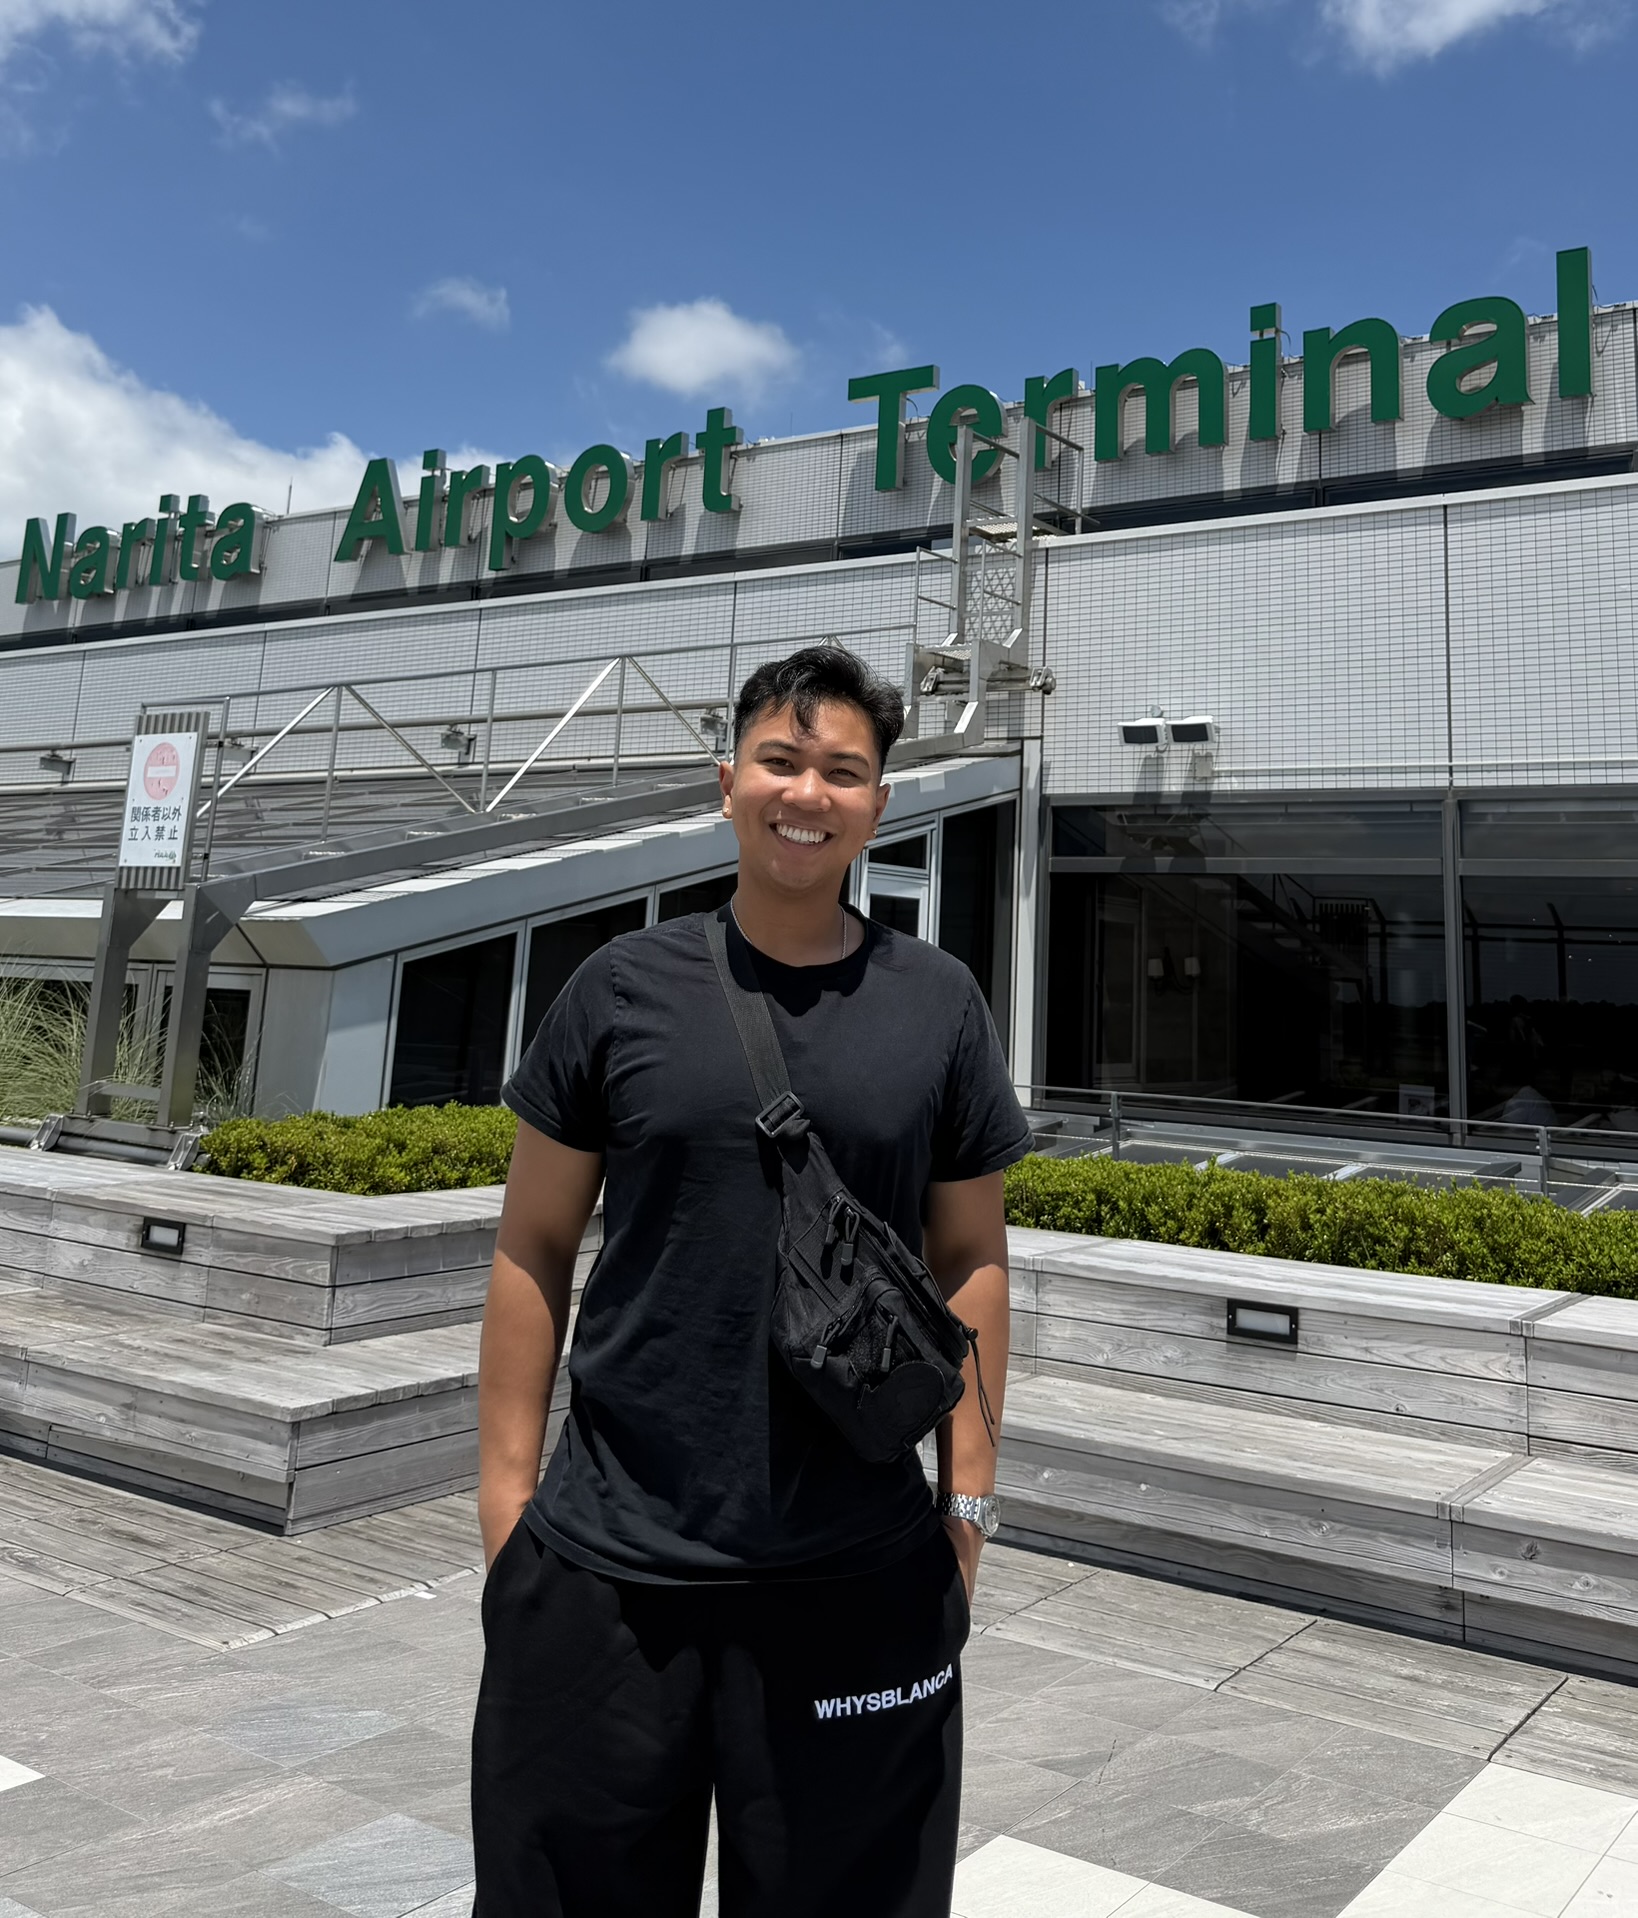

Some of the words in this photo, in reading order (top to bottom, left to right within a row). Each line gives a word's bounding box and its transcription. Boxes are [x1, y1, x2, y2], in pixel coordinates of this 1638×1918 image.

[16, 495, 260, 603] Narita
[335, 407, 742, 571] Airport
[848, 247, 1593, 491] Terminal
[130, 806, 182, 823] 関係者以外
[127, 825, 179, 842] 立入禁止
[814, 1663, 953, 1719] WHYSBLANCA
